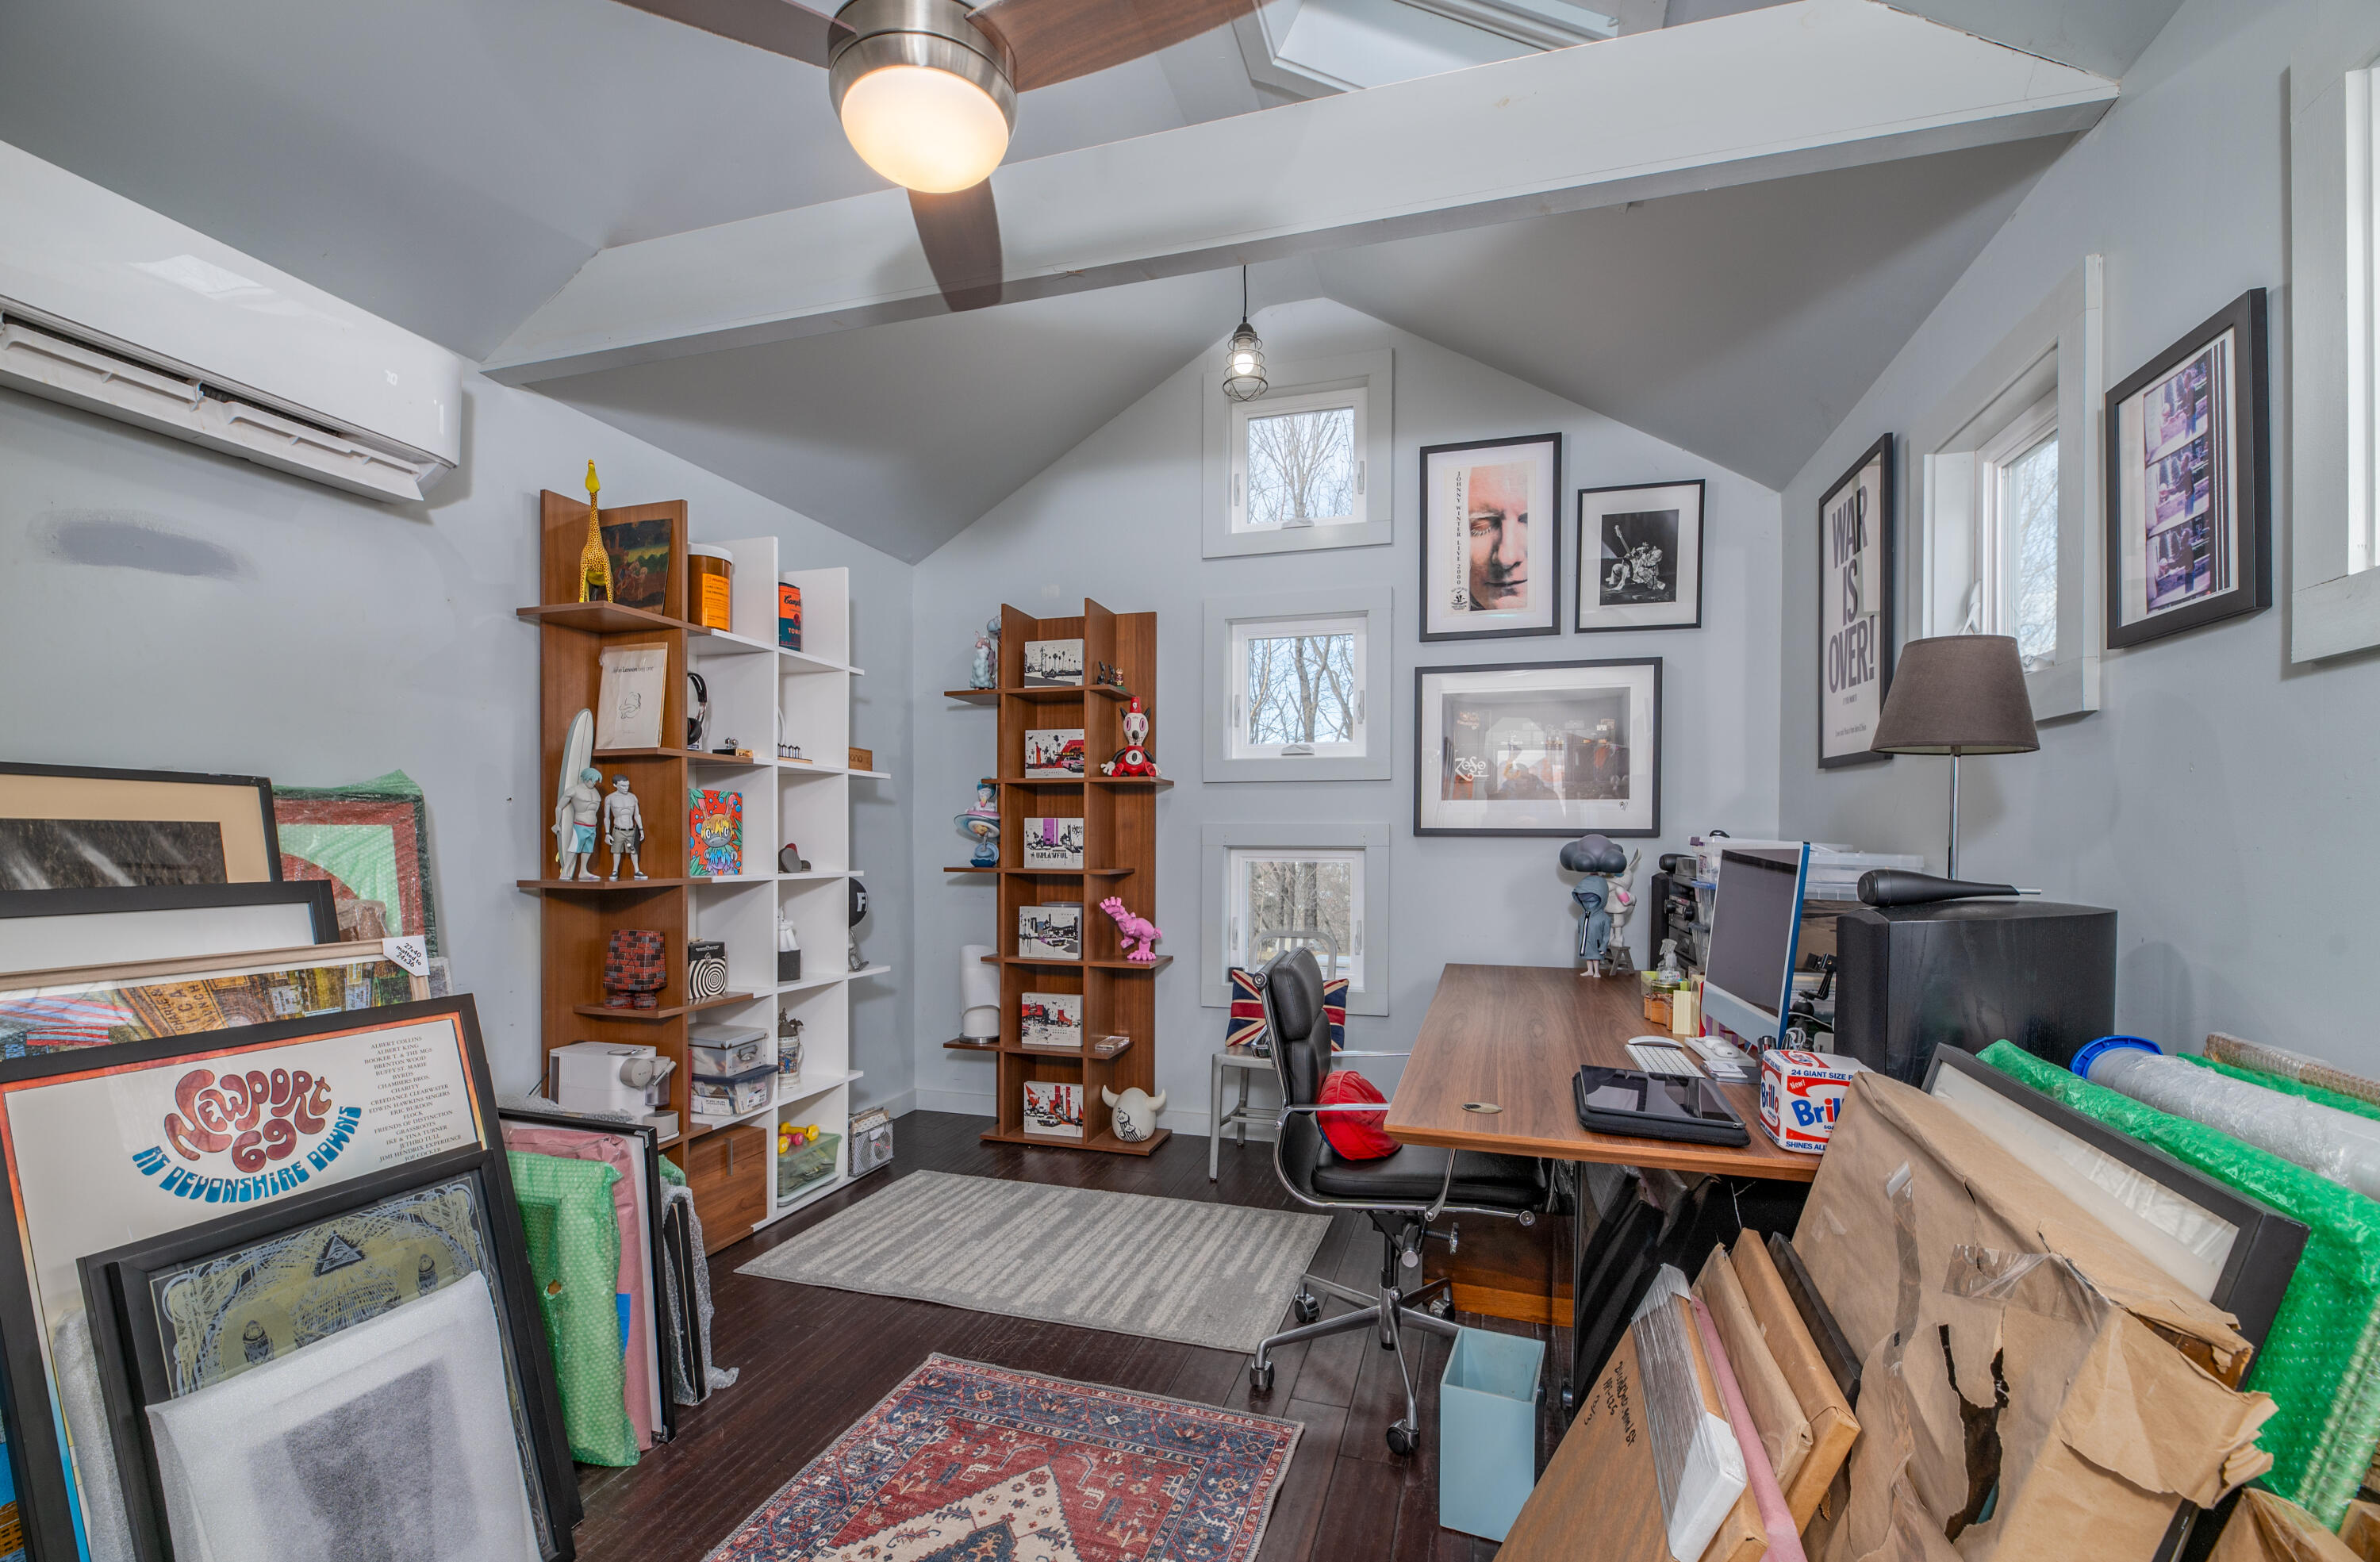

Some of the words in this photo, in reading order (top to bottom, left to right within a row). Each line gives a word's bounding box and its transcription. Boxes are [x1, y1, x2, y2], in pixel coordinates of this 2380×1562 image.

[1832, 485, 1868, 569] WAR
[1843, 558, 1858, 627] IS
[1829, 614, 1875, 693] OVER!
[396, 946, 416, 961] matted
[404, 942, 422, 958] 27x40
[396, 952, 415, 967] 24x36
[370, 1041, 395, 1050] ALBERT
[397, 1036, 422, 1045] COLLINS
[364, 1055, 391, 1065] BOOKER
[374, 1060, 405, 1069] BRENTON
[375, 1068, 395, 1077] BUFFY
[408, 1061, 427, 1070] MARIE
[1829, 1072, 1846, 1080] SIZE
[378, 1078, 412, 1089] CHAMBERS
[390, 1084, 420, 1093] CHARITY
[1790, 1079, 1806, 1090] New!
[369, 1103, 392, 1114] EDWIN
[393, 1096, 424, 1107] HAWKINS
[425, 1091, 451, 1100] SINGERS
[370, 1092, 408, 1106] CREEDANCE
[409, 1084, 449, 1096] CLEARWATER
[1761, 1081, 1779, 1114] Brillo
[406, 1101, 433, 1112] BURDON
[1791, 1098, 1844, 1127] Bril
[374, 1123, 402, 1134] FRIENDS
[413, 1110, 453, 1124] DISTINCTION
[402, 1111, 424, 1120] FLOCK
[396, 1122, 436, 1136] GRASSROOTS
[423, 1125, 447, 1134] TURNER
[132, 1145, 171, 1176] AT
[306, 1106, 362, 1172] DOWNS
[232, 1118, 297, 1173] 69
[394, 1146, 424, 1158] HENDRIX
[425, 1134, 462, 1149] EXPERIENCE
[400, 1138, 424, 1150] JETHRO
[424, 1134, 440, 1142] TULL
[1786, 1141, 1813, 1149] SHINES
[416, 1147, 441, 1158] COCKER
